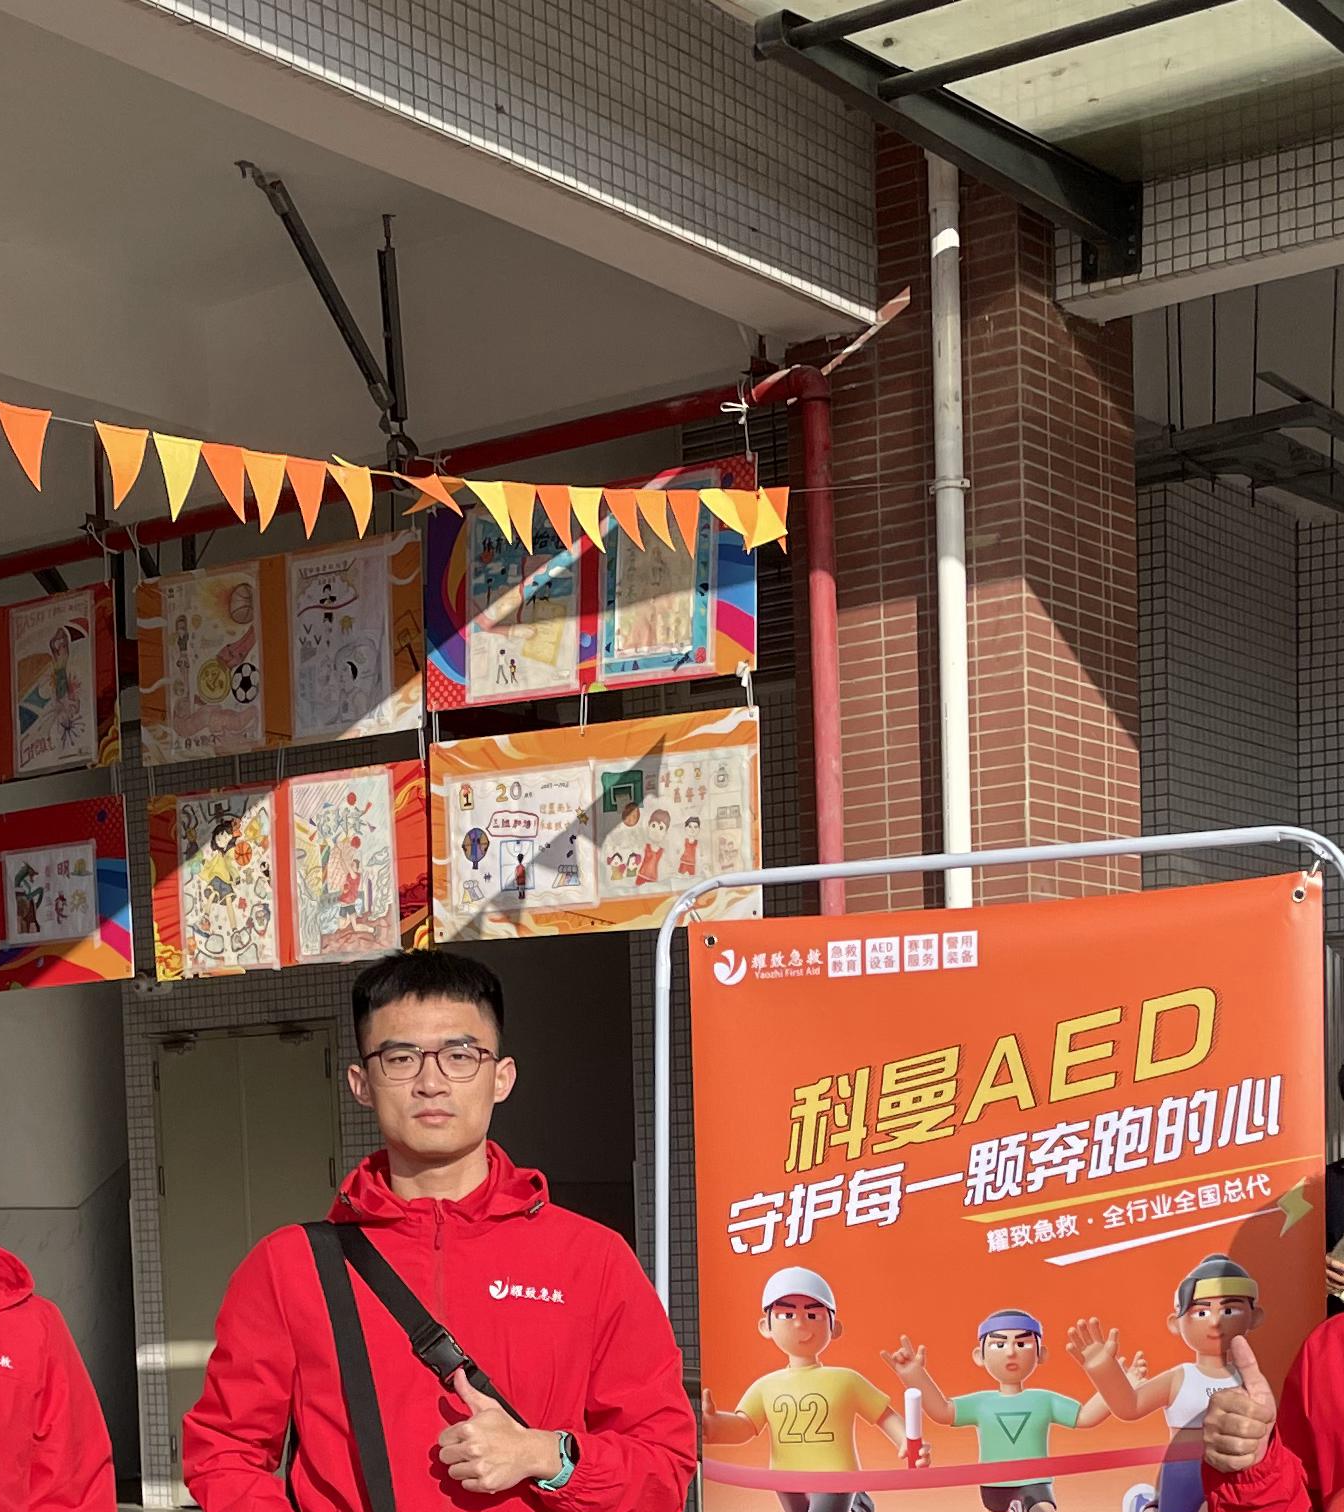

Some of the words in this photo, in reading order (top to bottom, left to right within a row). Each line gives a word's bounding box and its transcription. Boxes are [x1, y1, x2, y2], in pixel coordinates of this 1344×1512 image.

[871, 941, 893, 953] AED
[907, 938, 934, 953] 赛事
[946, 935, 974, 950] 警用
[751, 948, 823, 969] 耀致急救
[831, 945, 858, 959] 急救
[946, 950, 974, 964] 装备
[831, 959, 858, 973] 教育
[869, 955, 896, 969] 设备
[907, 953, 935, 967] 服务
[755, 969, 784, 980] Yaozhi
[785, 968, 805, 978] First
[806, 966, 821, 977] Aid
[785, 986, 1220, 1173] 科曼AED
[726, 1075, 1284, 1255] 守护每一颗奔跑的心
[773, 1393, 834, 1443] 22
